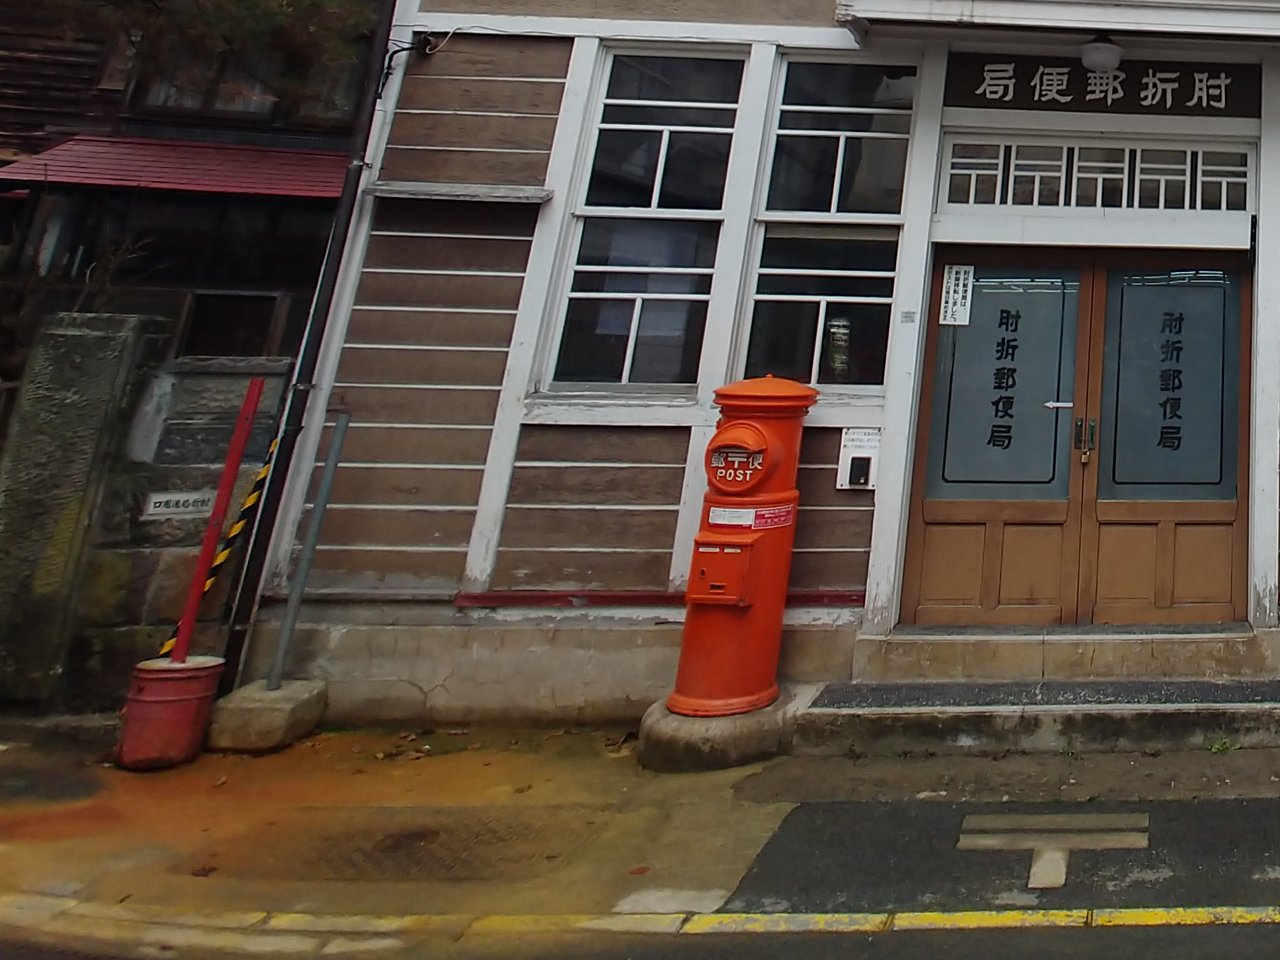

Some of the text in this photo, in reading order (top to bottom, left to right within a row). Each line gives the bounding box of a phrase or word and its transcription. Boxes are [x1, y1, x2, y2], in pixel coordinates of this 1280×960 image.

[987, 309, 1022, 450] 肘折郵便局
[1156, 311, 1185, 451] 肘折郵便局
[716, 469, 753, 481] POST
